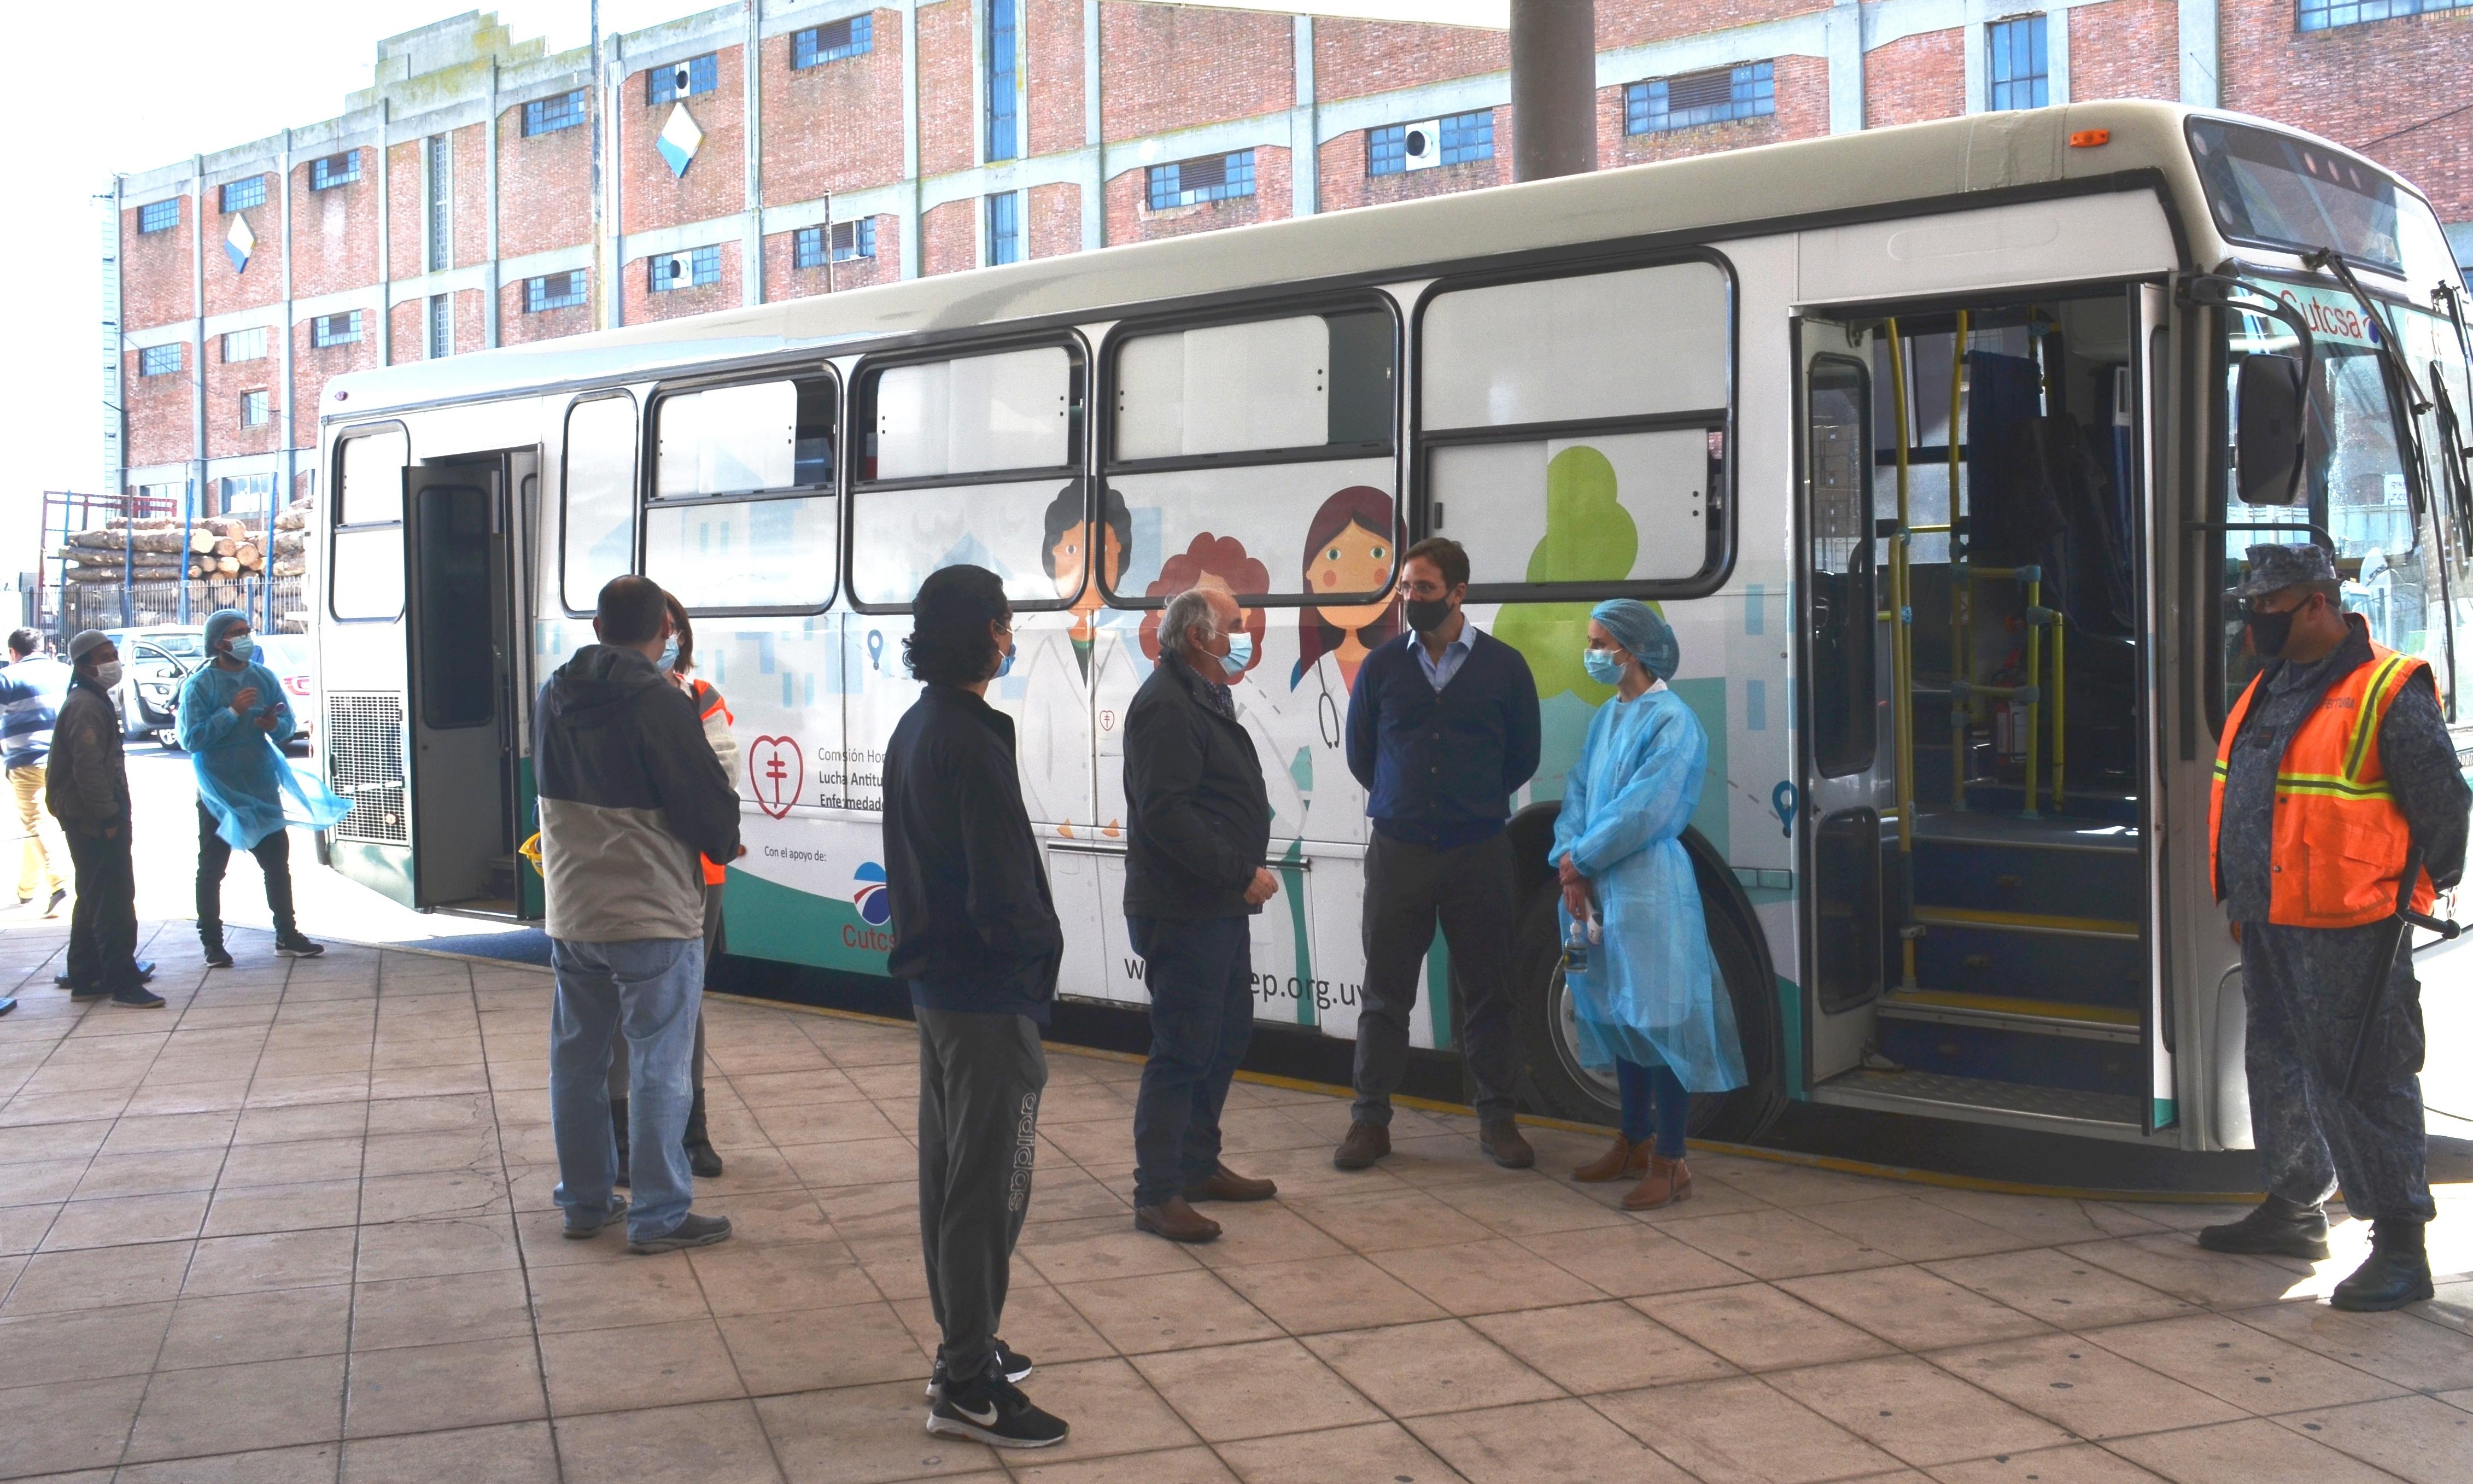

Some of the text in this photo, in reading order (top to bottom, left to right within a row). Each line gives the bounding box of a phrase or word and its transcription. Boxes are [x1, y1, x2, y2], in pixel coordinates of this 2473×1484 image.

[819, 747, 864, 762] Comsión
[819, 771, 847, 785] Lucha
[764, 846, 827, 862] Con el apoyo de:
[1008, 1092, 1036, 1211] adidas
